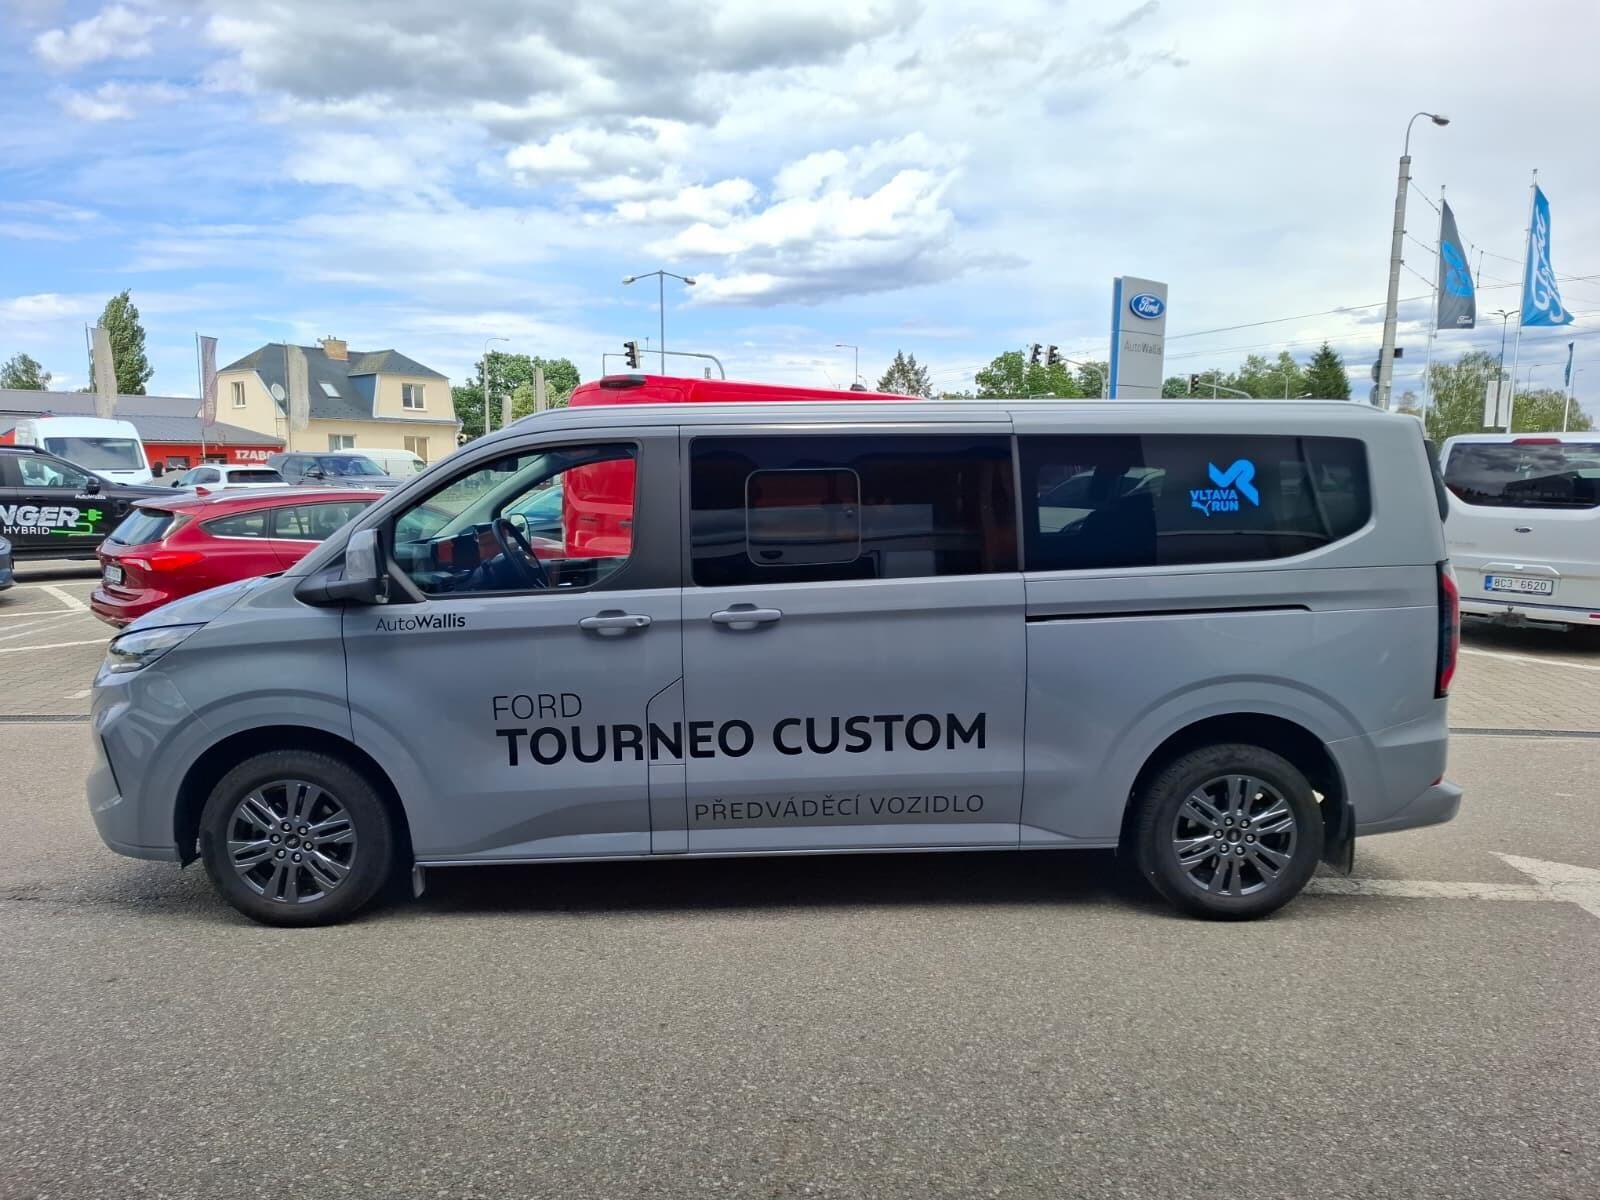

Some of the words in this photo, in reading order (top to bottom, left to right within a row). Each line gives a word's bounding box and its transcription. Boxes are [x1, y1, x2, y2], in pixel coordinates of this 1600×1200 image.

[1138, 296, 1160, 314] Ford
[1189, 489, 1238, 500] VLTAVA
[1211, 500, 1239, 511] RUN
[0, 504, 80, 527] NGER
[3, 526, 50, 535] HYBRID
[1520, 580, 1547, 591] 6620
[376, 613, 466, 632] AutoWallis
[493, 693, 582, 721] FORD
[496, 719, 754, 766] TOURNEO
[773, 712, 986, 756] CUSTOM
[695, 794, 860, 821] PŘEDVÁDĚCÍ
[870, 794, 984, 815] VOZIDLO
